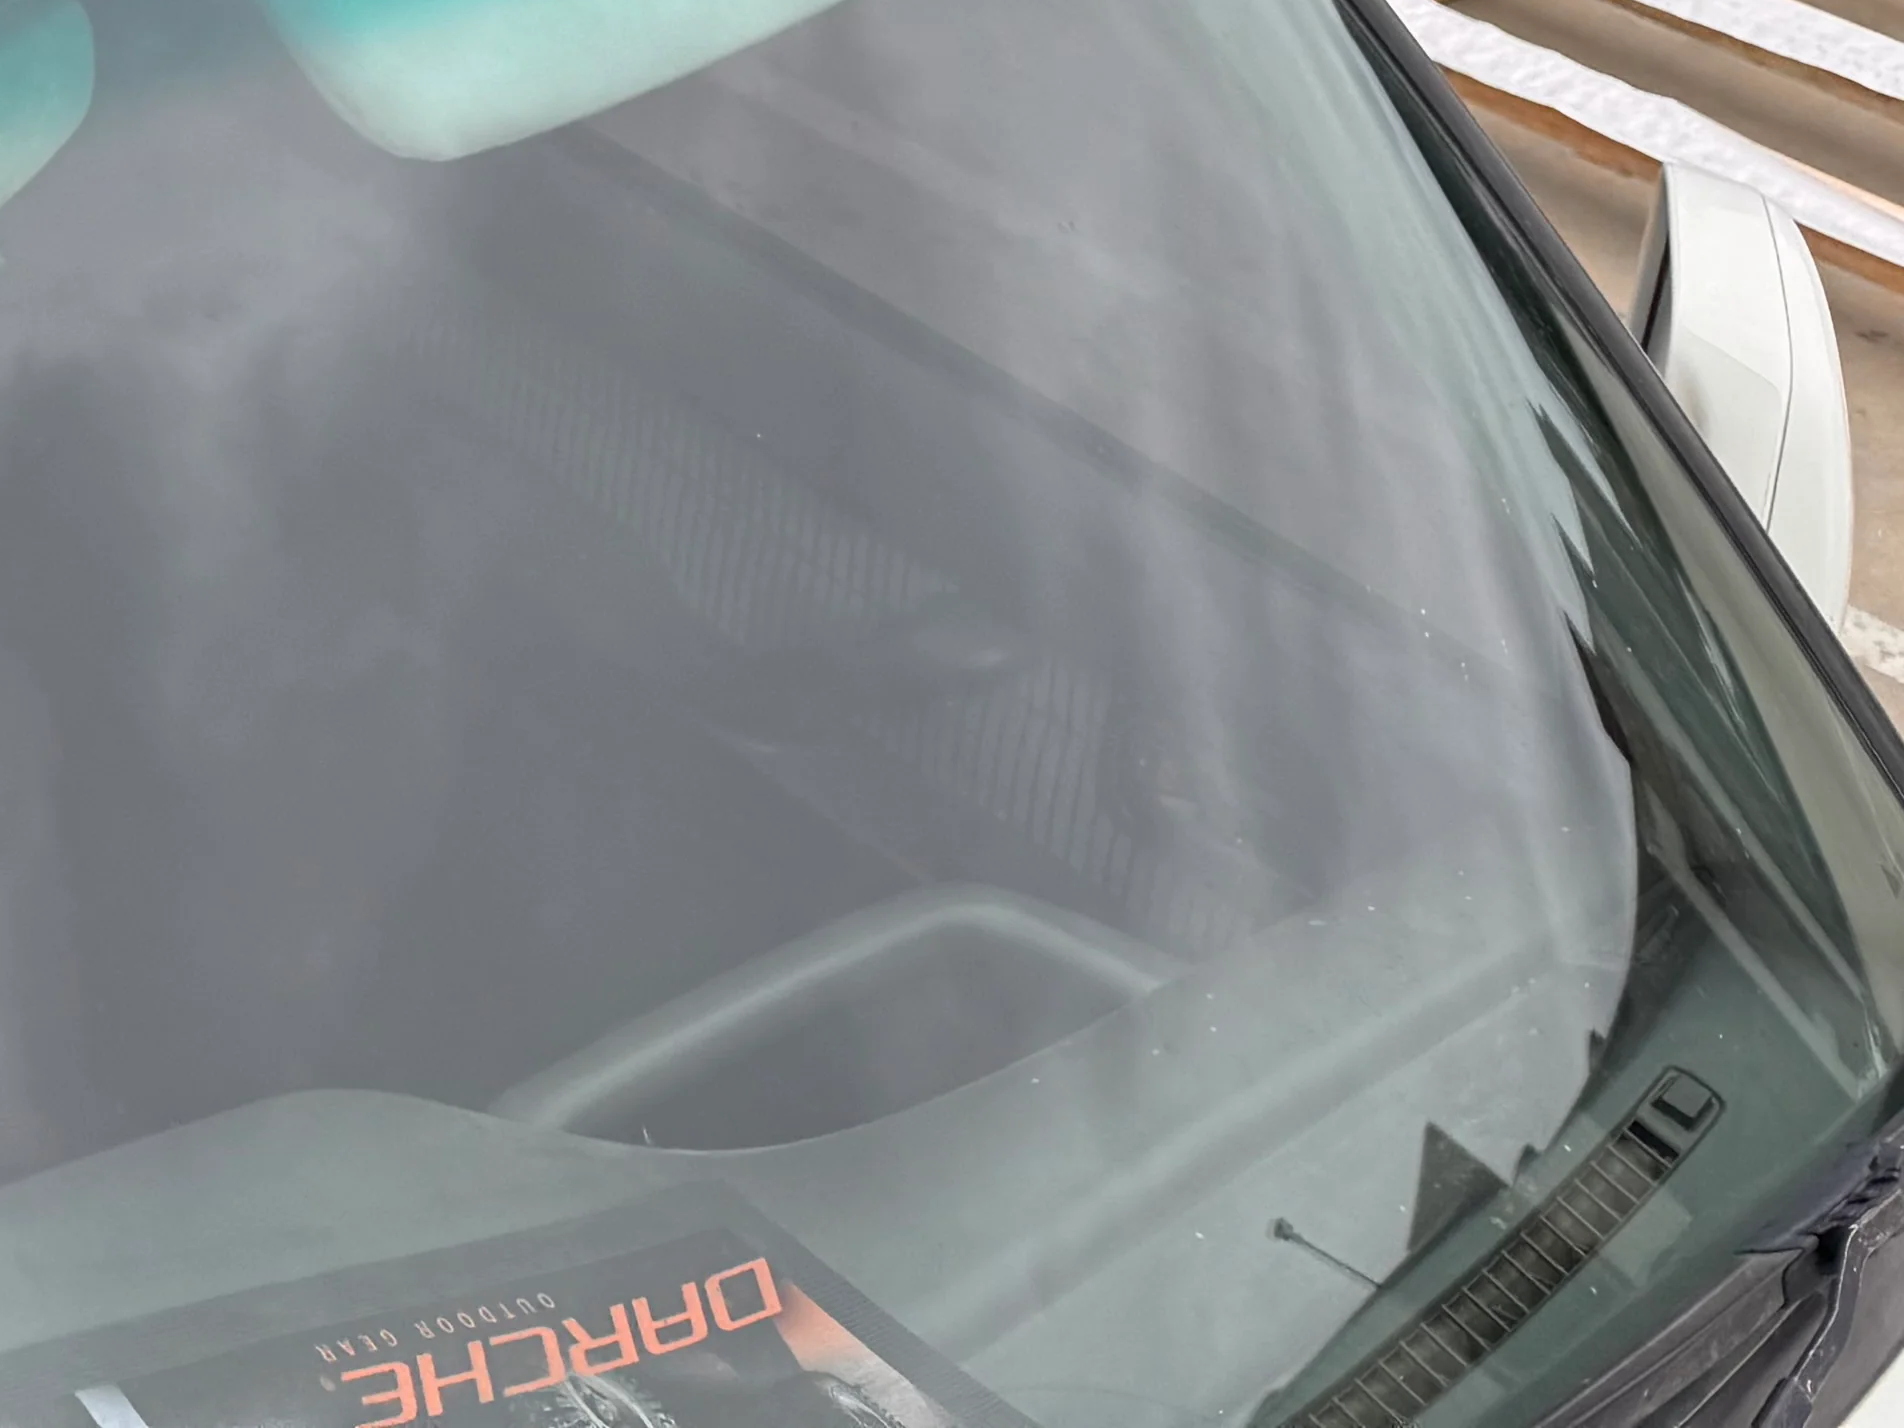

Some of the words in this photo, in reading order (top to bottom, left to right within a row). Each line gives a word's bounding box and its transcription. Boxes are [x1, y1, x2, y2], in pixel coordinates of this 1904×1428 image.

[414, 1292, 555, 1339] OUTDOOR
[315, 1328, 398, 1363] GEAR
[341, 1260, 783, 1428] DARCHE
